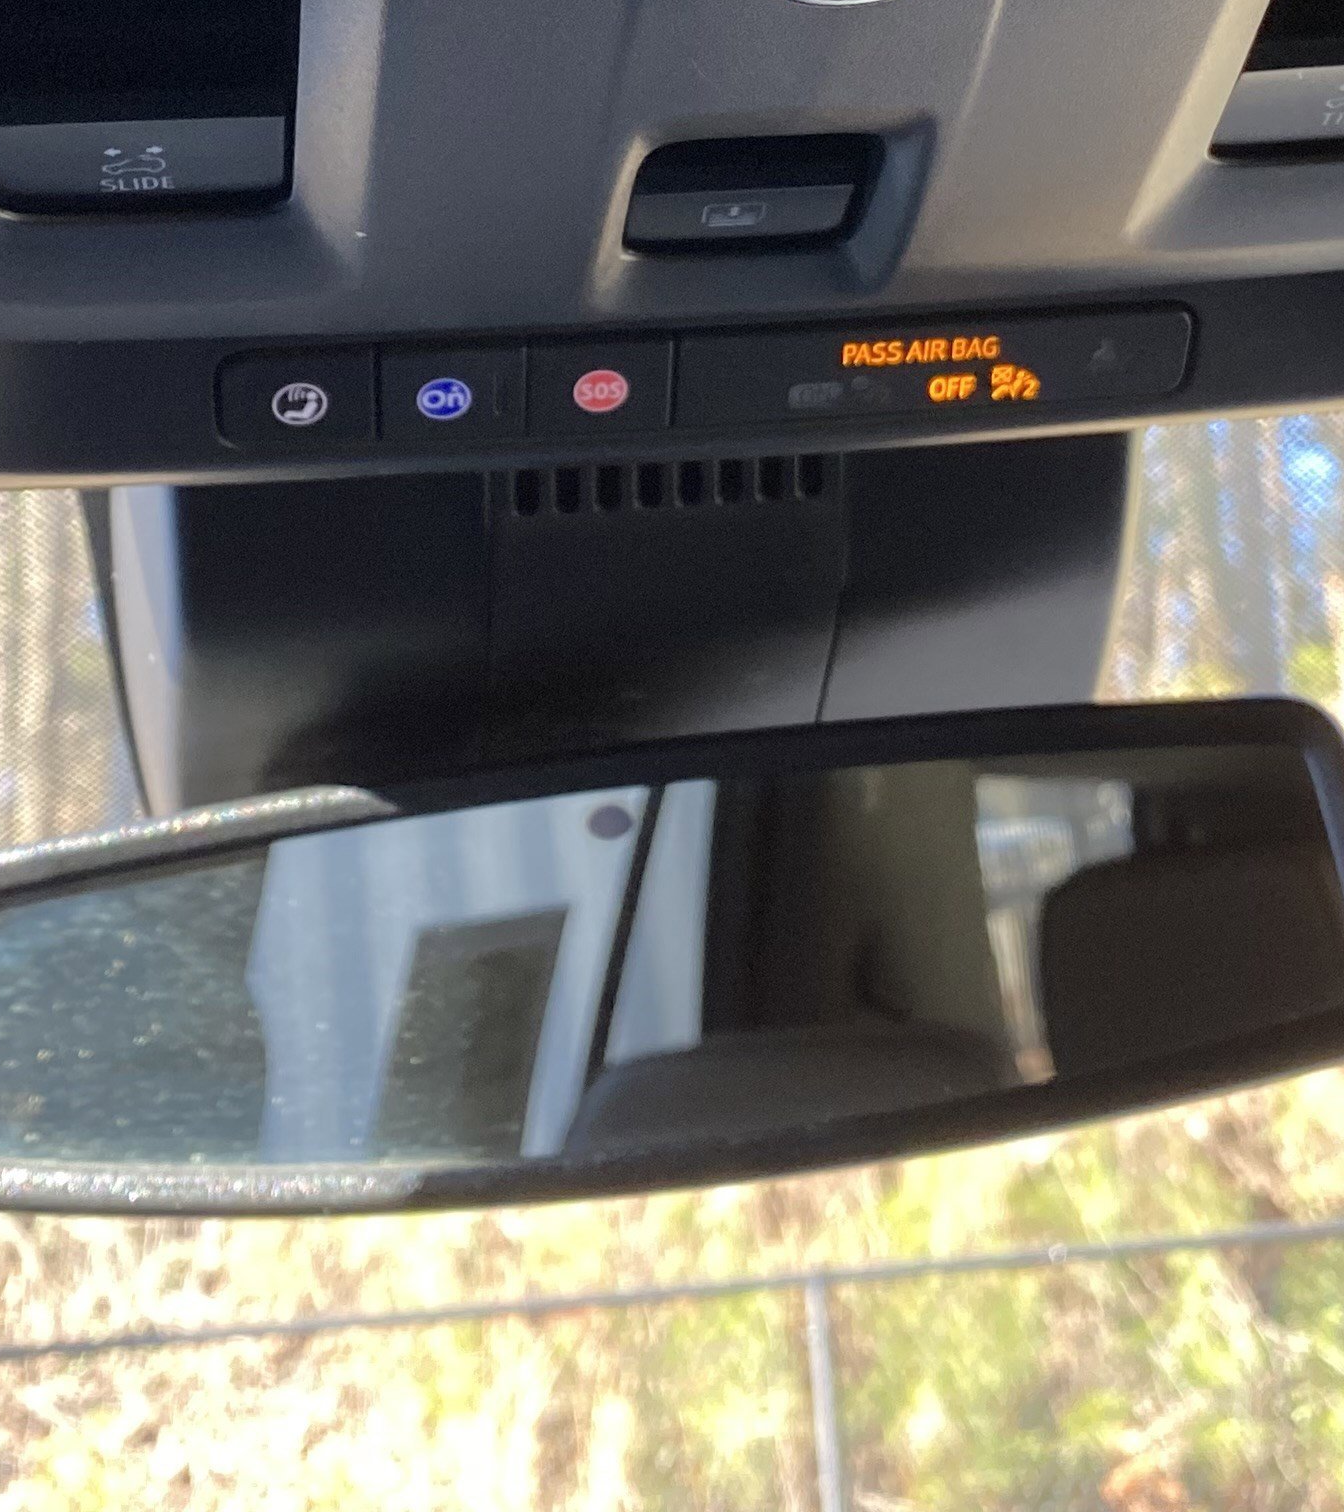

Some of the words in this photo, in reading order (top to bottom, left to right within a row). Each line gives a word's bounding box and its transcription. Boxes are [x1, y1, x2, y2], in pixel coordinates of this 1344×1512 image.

[98, 175, 175, 192] SLIDE
[842, 341, 904, 366] PASS
[905, 339, 948, 364] AIR
[951, 336, 1000, 361] BAG
[579, 380, 622, 401] SOS
[928, 373, 977, 402] OFF
